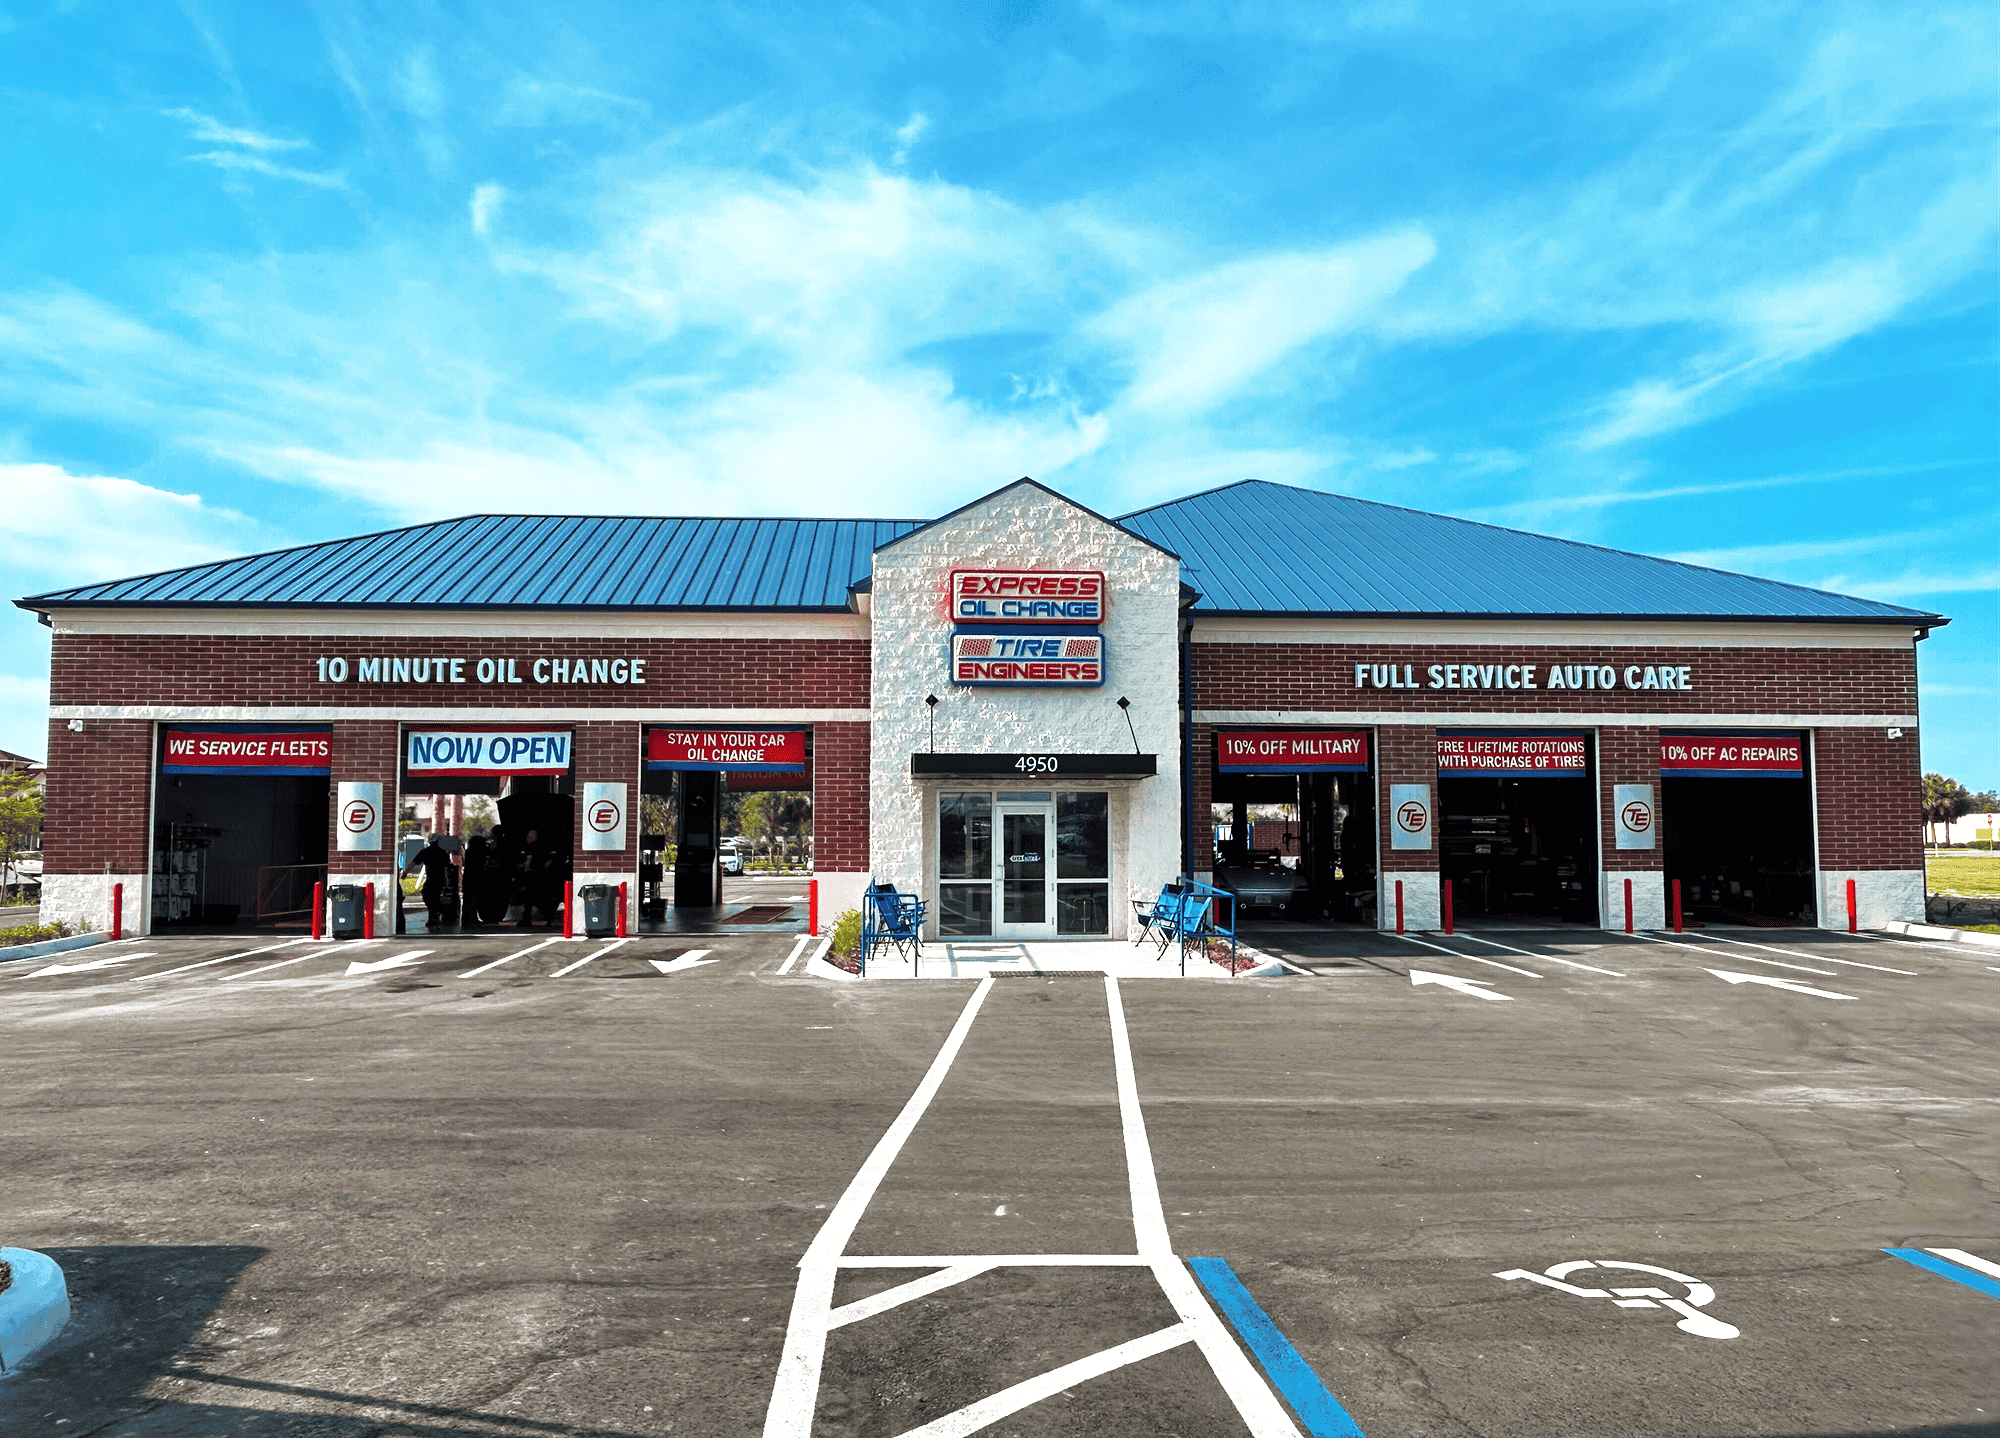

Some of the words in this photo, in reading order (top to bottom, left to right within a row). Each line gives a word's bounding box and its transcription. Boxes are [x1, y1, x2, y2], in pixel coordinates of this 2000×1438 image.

[960, 576, 1100, 595] EXPRESS
[960, 600, 996, 616] OIL
[1001, 600, 1098, 617] CHANGE
[996, 639, 1061, 657] TIRE
[316, 657, 349, 683] 10
[358, 657, 467, 683] MINUTE
[476, 657, 523, 684] OIL
[533, 657, 647, 684] CHANGE
[958, 662, 1099, 680] ENGINEERS
[1355, 664, 1420, 688] FULL
[1427, 664, 1537, 689] SERVICE
[1547, 664, 1616, 690] AUTO
[1623, 665, 1693, 690] CARE
[169, 739, 196, 755] WE
[199, 740, 268, 756] SERVICE
[270, 741, 329, 757] FLEETS
[667, 733, 699, 746] STAY
[703, 734, 717, 747] IN
[720, 734, 756, 747] YOUR
[759, 734, 786, 747] CAR
[1226, 739, 1256, 755] 10%
[1259, 740, 1288, 755] OFF
[1292, 738, 1361, 755] MILITARY
[1437, 741, 1465, 753] FREE
[1467, 741, 1519, 753] LIFETIME
[1521, 741, 1585, 753] ROTATIONS
[413, 736, 483, 764] NOW
[488, 736, 566, 765] OPEN
[687, 748, 709, 761] OIL
[711, 748, 765, 762] CHANGE
[1660, 746, 1688, 761] 10%
[1690, 746, 1716, 761] OFF
[1719, 747, 1738, 761] AC
[1741, 747, 1799, 762] REPAIRS
[1014, 756, 1059, 772] 4950
[1438, 755, 1469, 767] WITH
[1471, 755, 1532, 768] PURCHASE
[1534, 756, 1550, 768] OF
[1552, 756, 1585, 768] TIRES
